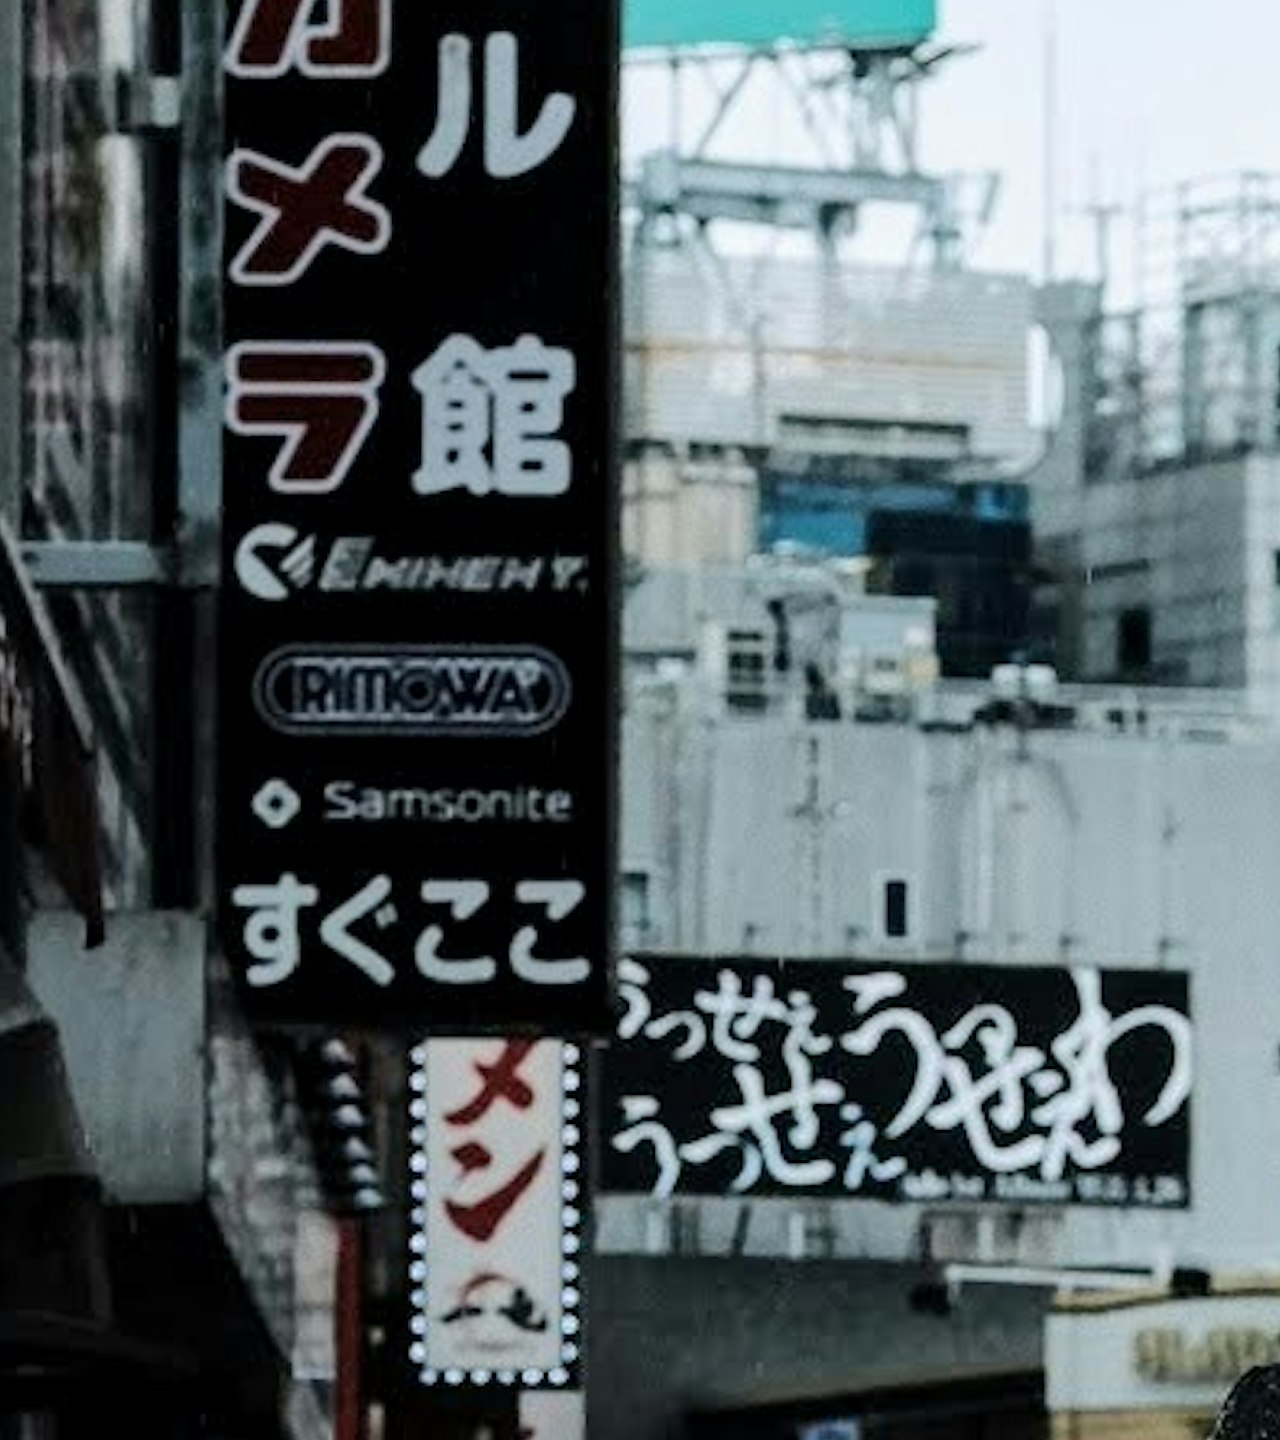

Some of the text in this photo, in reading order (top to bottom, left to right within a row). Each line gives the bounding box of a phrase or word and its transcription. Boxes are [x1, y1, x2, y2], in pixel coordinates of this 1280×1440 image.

[323, 781, 573, 824] Samsonite
[231, 871, 593, 988] すぐここ
